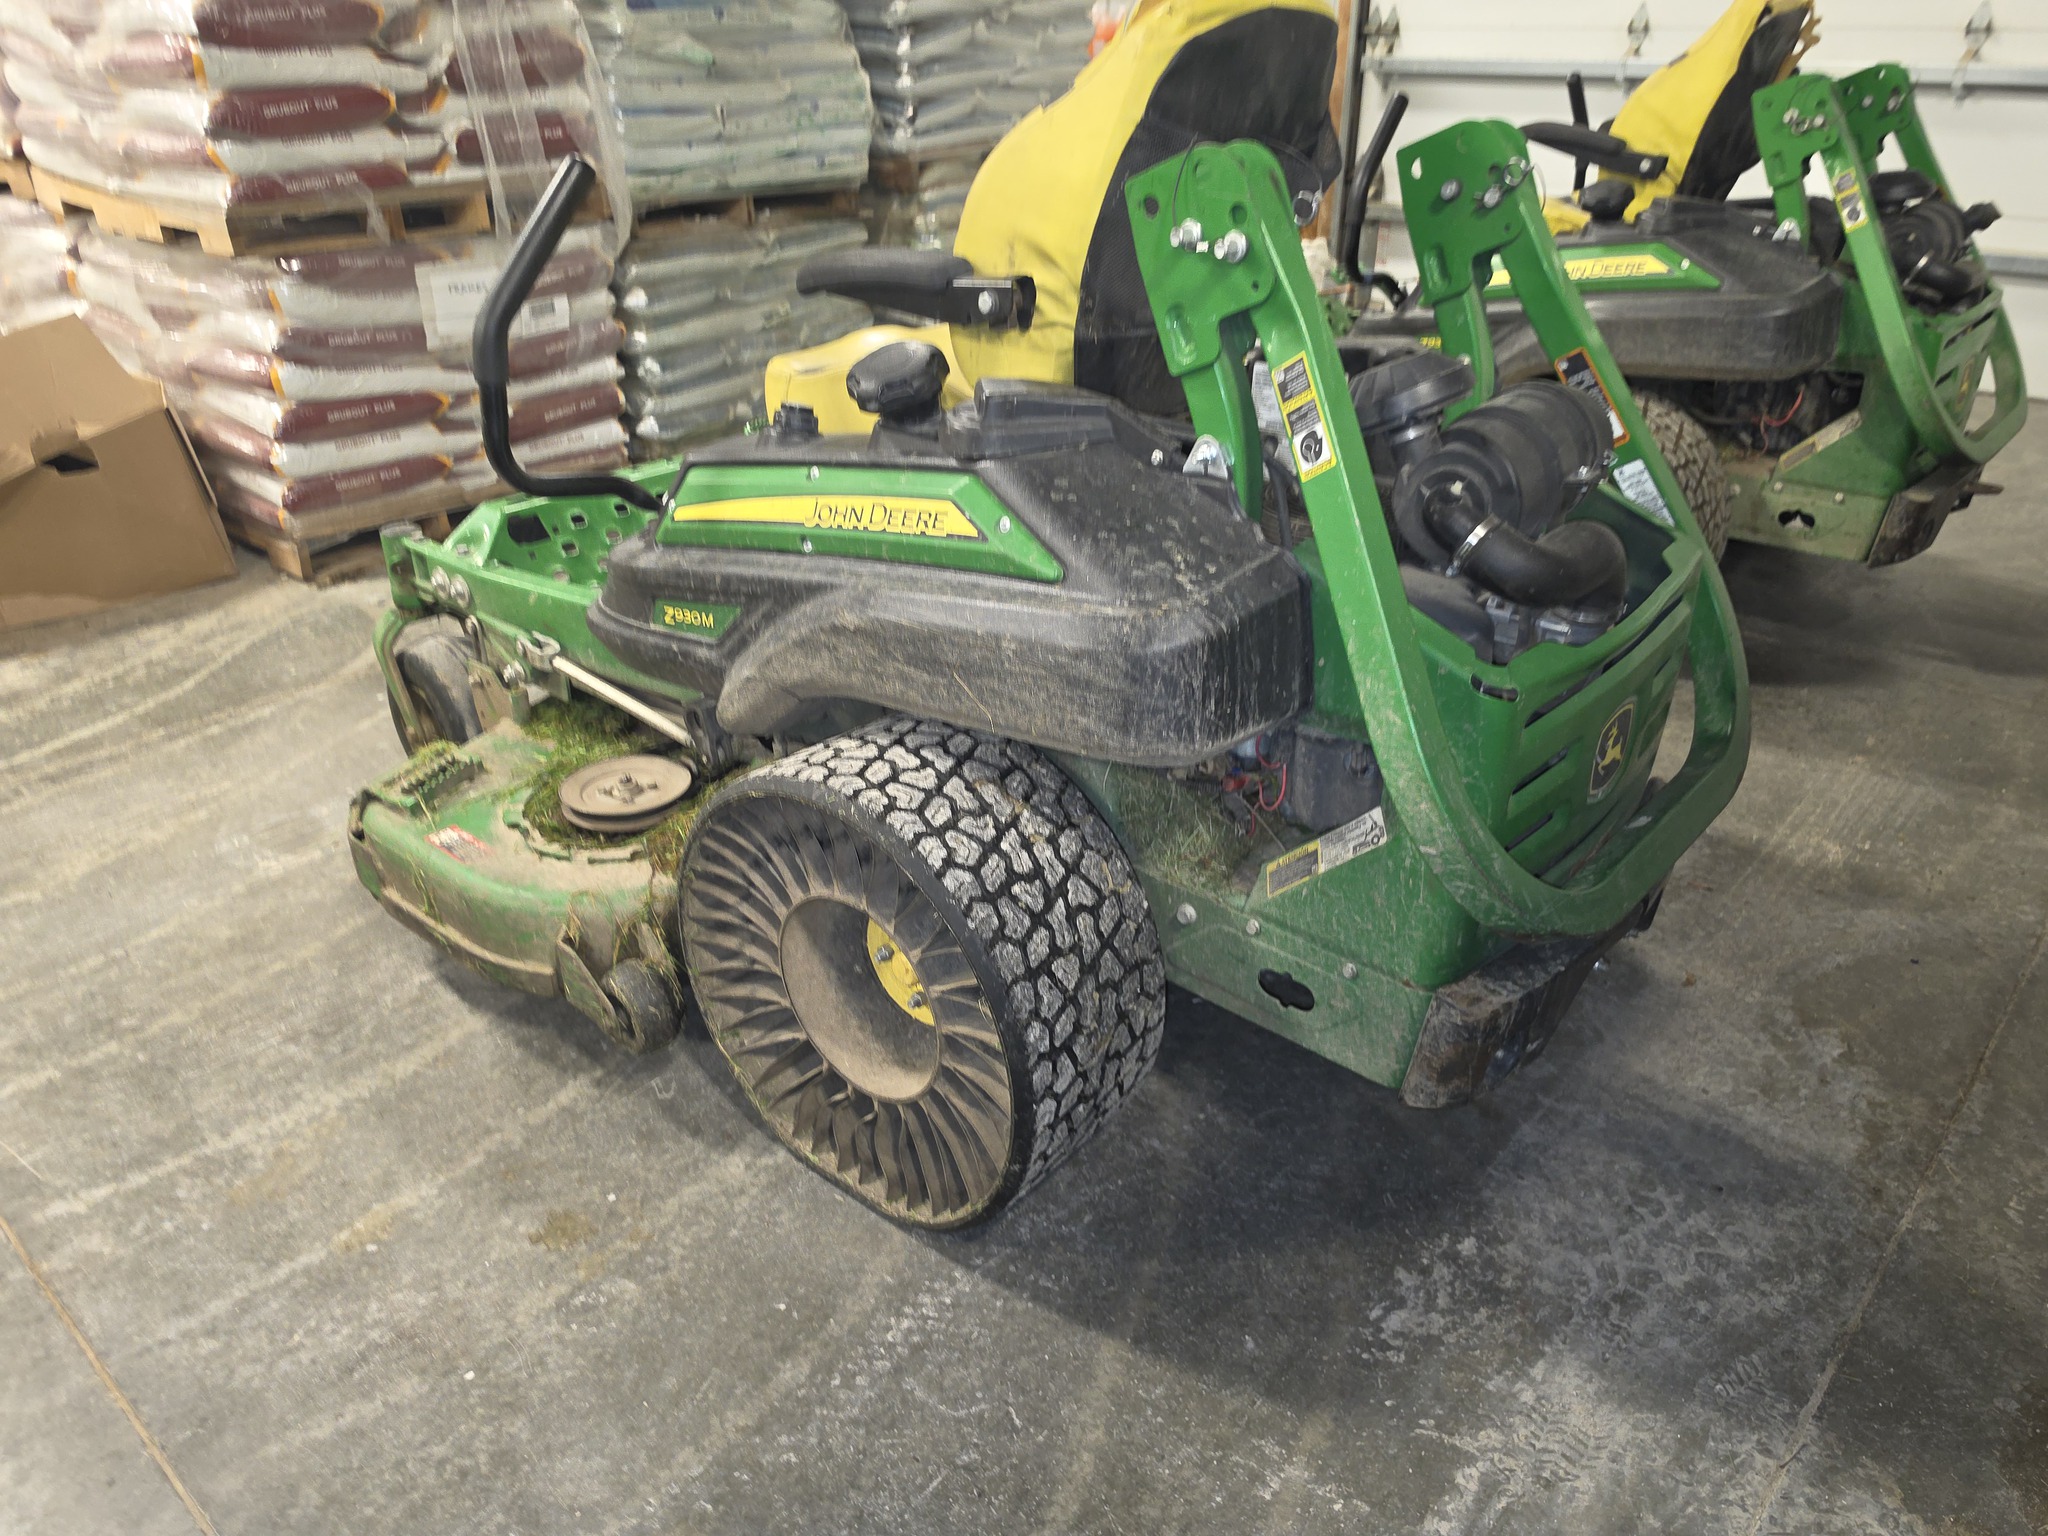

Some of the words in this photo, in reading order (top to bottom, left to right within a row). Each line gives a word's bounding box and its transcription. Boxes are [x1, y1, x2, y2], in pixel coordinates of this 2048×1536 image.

[1589, 259, 1648, 278] DEERE
[803, 497, 866, 530] JOHN
[867, 502, 948, 537] DEERE
[663, 605, 714, 629] Z930M
